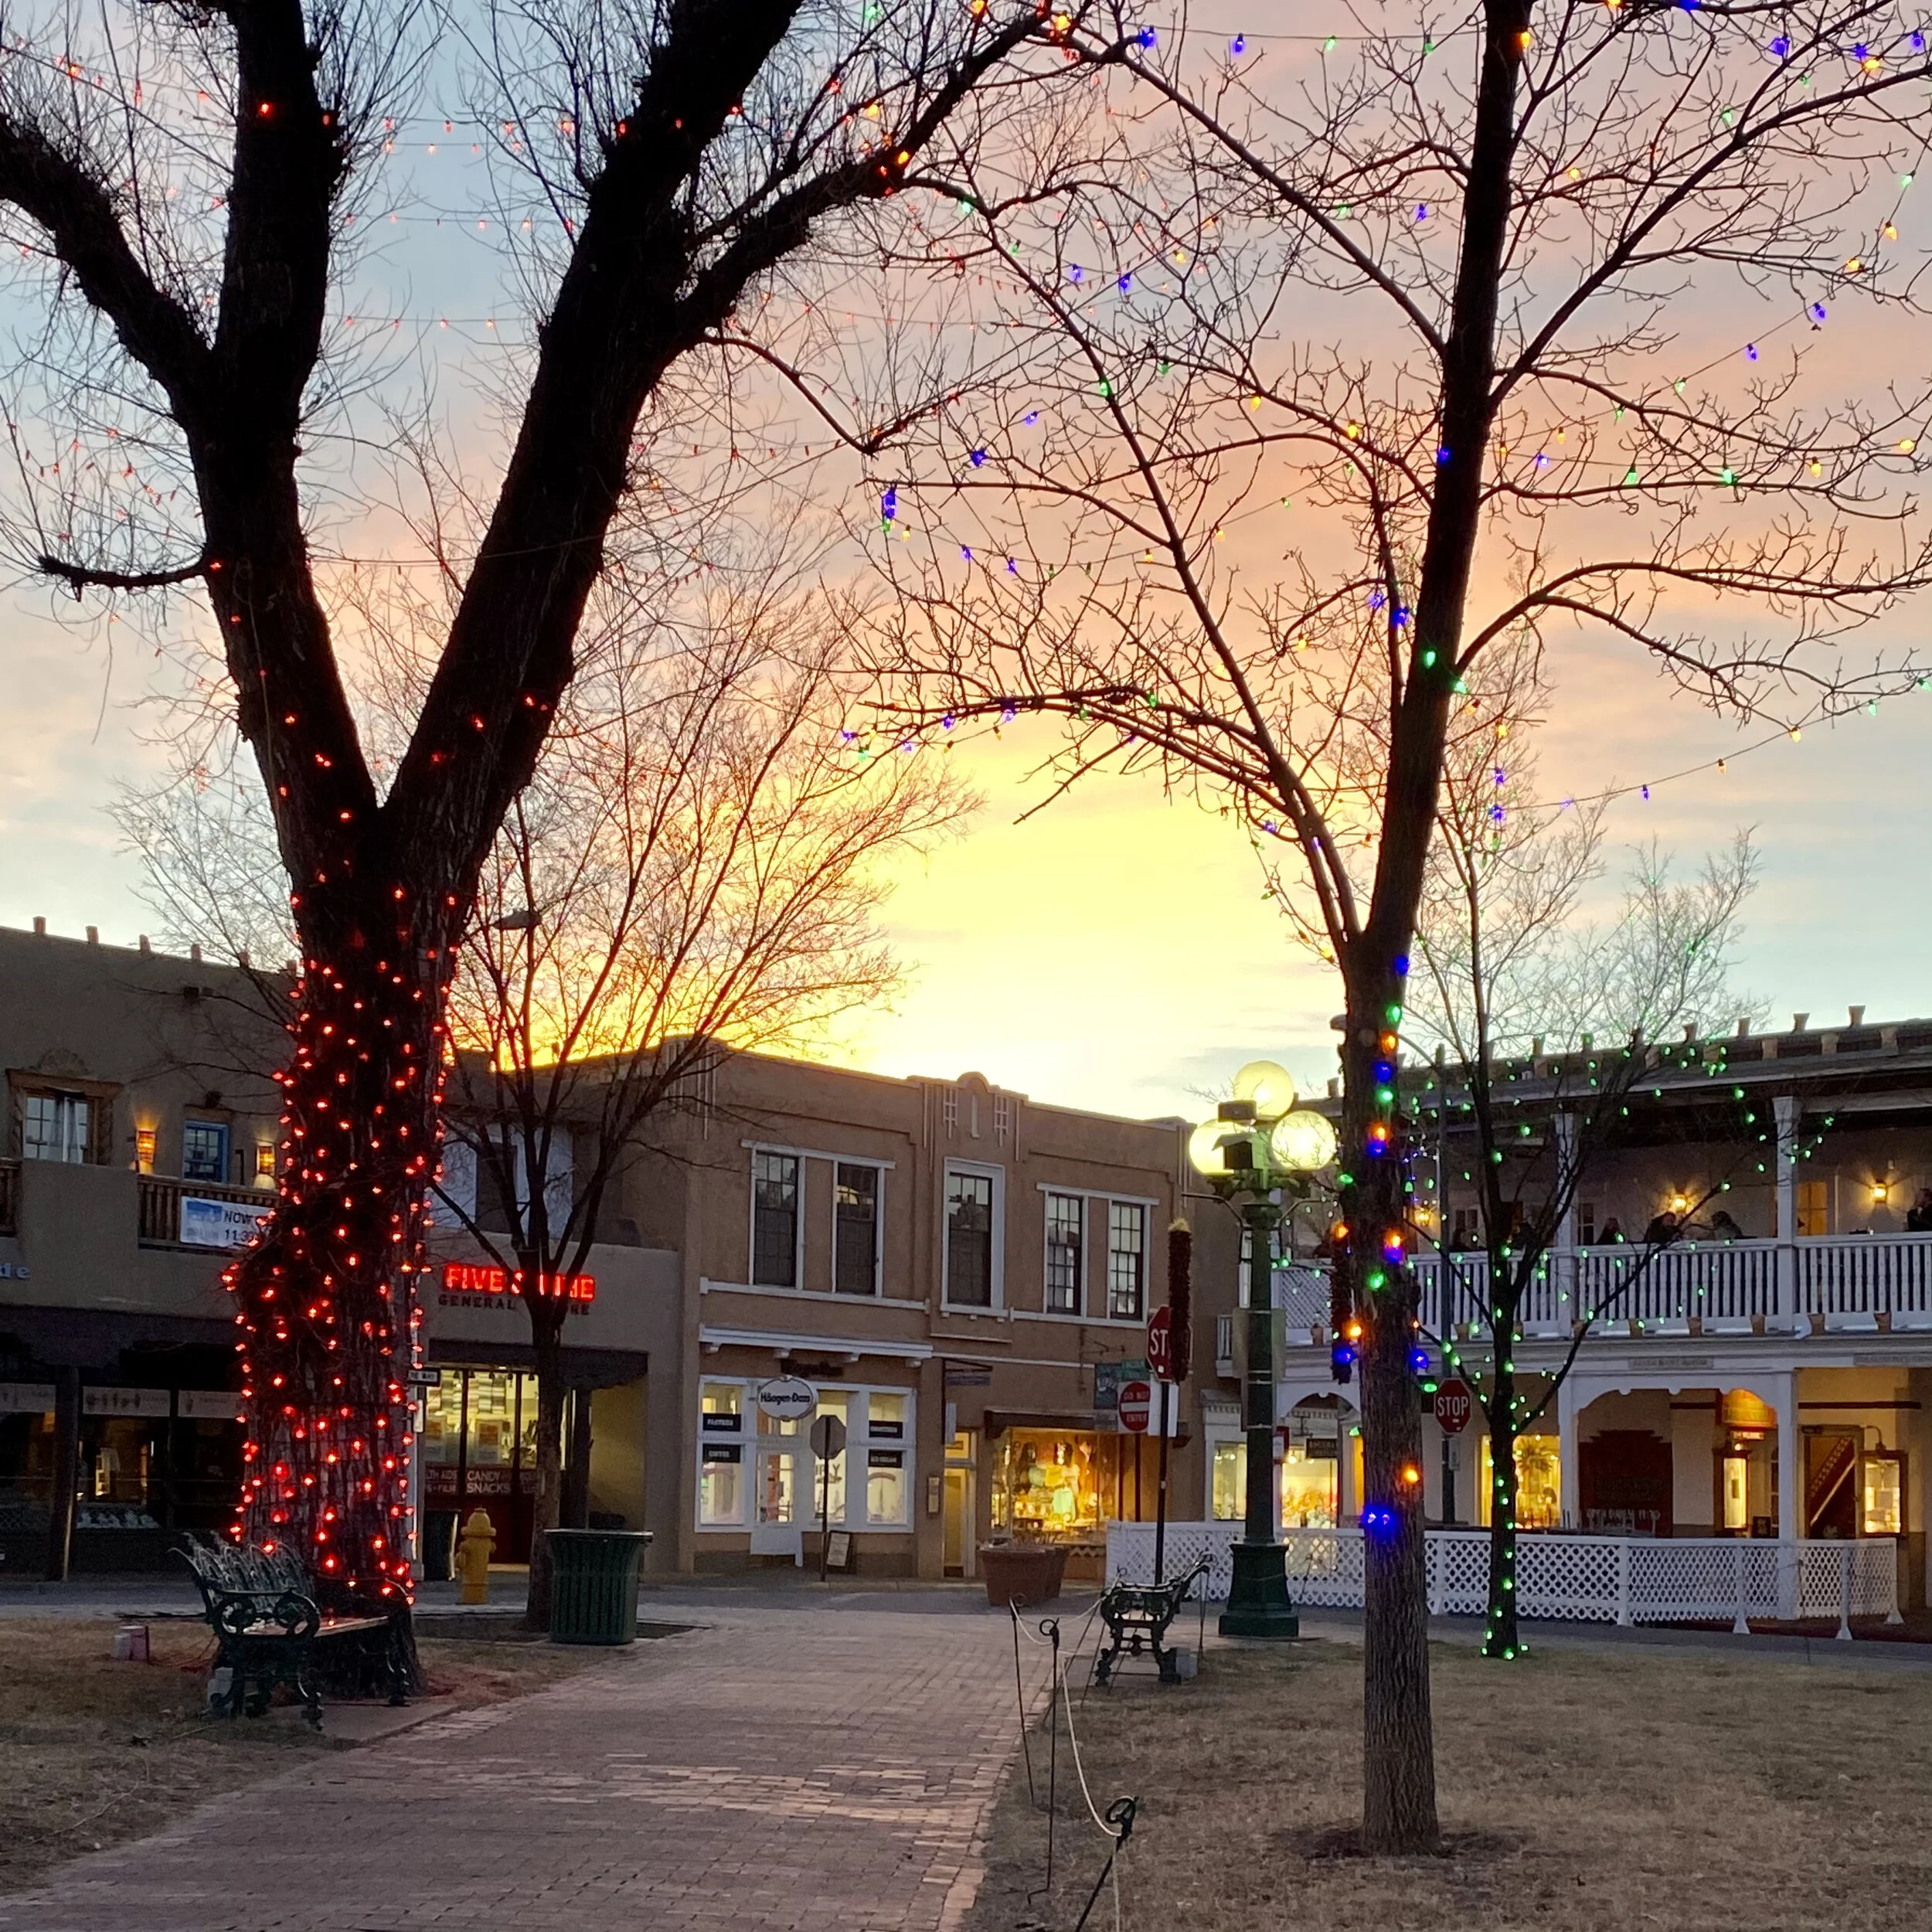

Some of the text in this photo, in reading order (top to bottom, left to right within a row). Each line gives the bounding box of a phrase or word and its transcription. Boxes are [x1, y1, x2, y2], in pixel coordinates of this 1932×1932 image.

[445, 1267, 505, 1292] FIVE
[438, 1294, 517, 1310] GENERAL
[1437, 1395, 1469, 1417] STOP
[467, 1470, 501, 1481] CANDY
[467, 1483, 512, 1495] SNACKS
